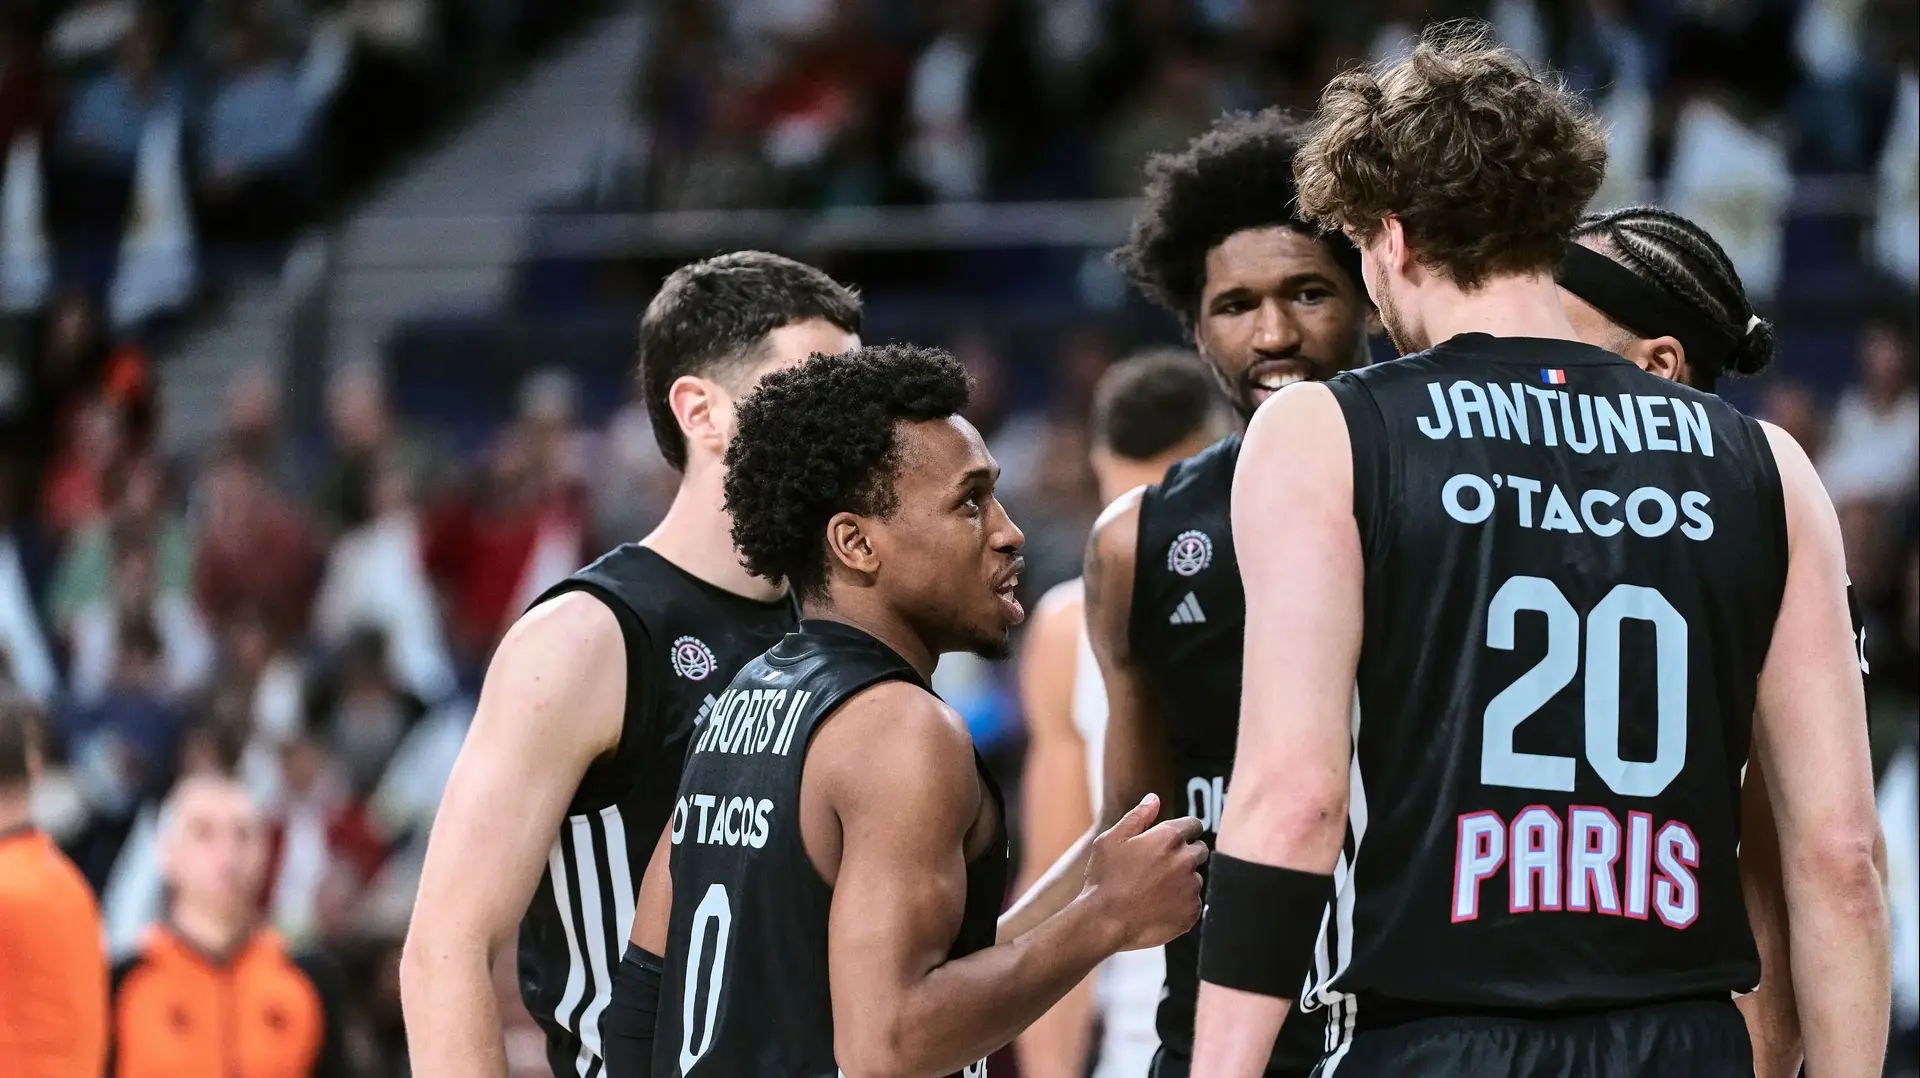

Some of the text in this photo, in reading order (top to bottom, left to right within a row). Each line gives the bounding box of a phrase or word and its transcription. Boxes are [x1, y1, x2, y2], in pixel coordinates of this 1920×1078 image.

[1416, 380, 1715, 457] JANTUNEN
[1441, 473, 1715, 541] O'TACOS
[674, 635, 718, 672] BASKETBALL
[1481, 575, 1688, 797] 20
[671, 793, 775, 849] O'TACOS
[1451, 804, 1699, 930] PARIS
[679, 883, 732, 1078] 0
